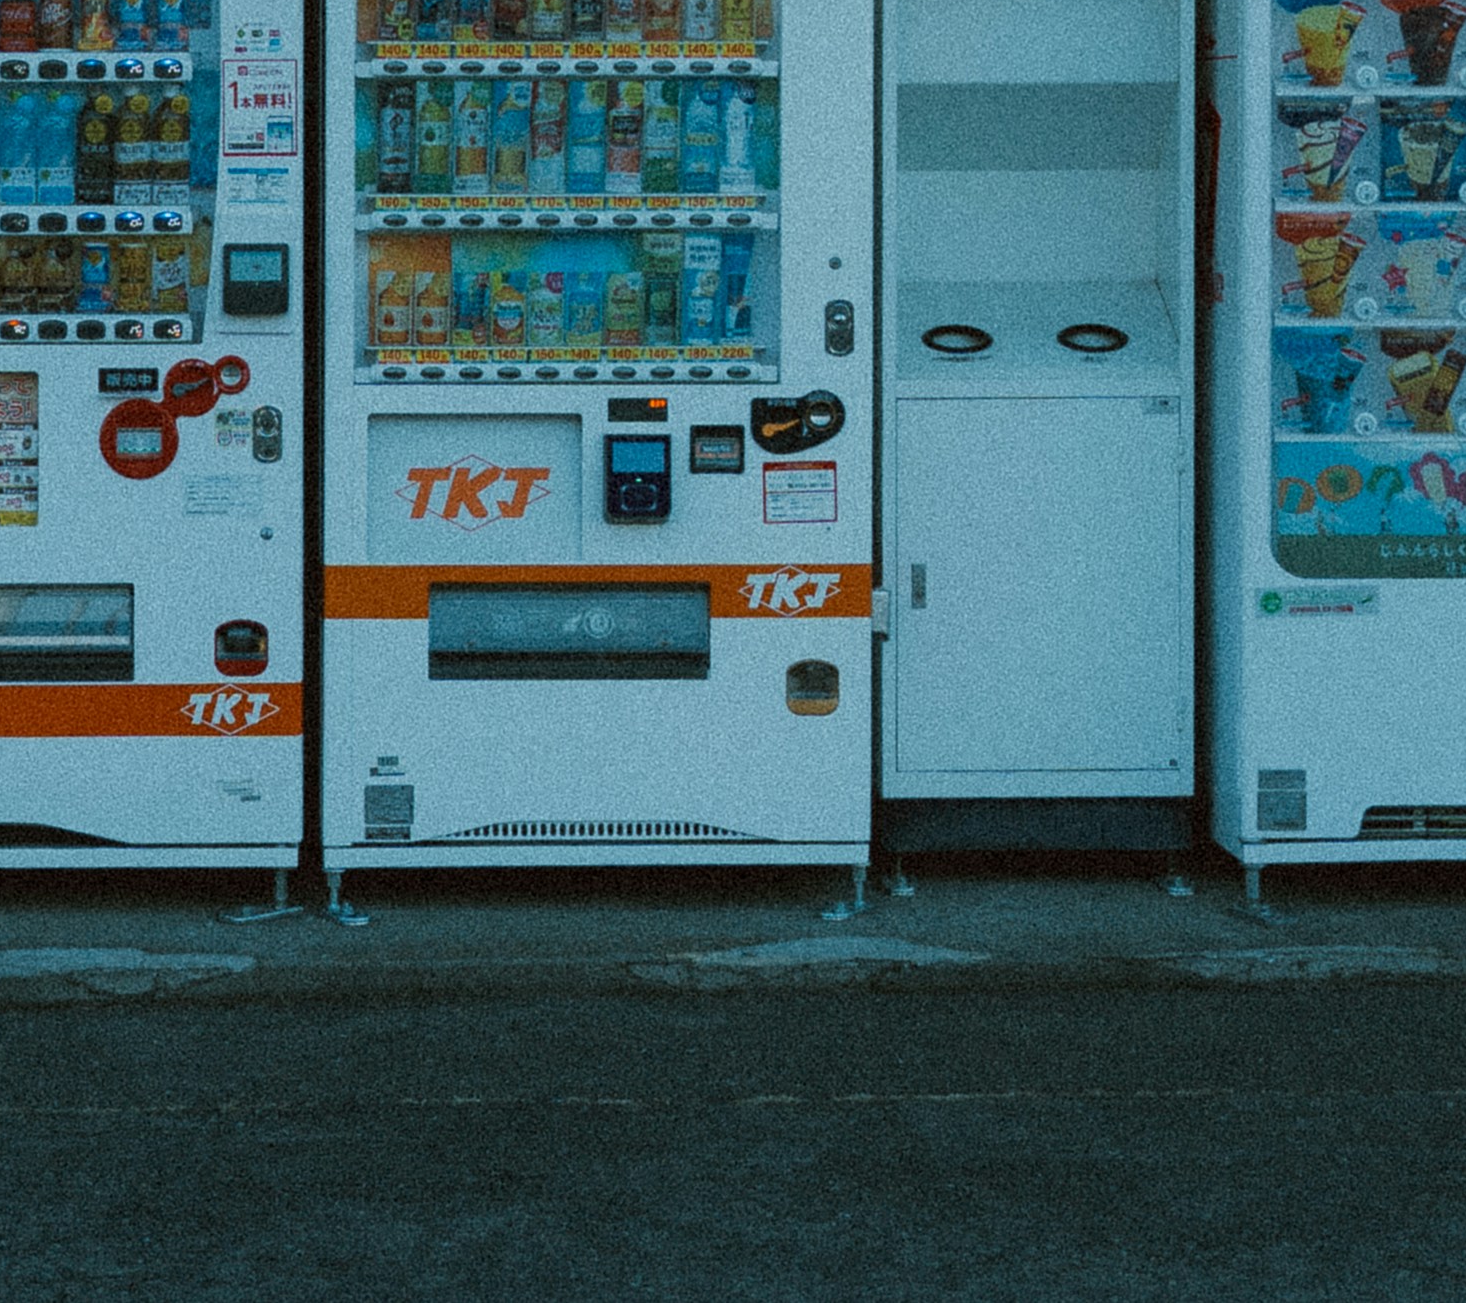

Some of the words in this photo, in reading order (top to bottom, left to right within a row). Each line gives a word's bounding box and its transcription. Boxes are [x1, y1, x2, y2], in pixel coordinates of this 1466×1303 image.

[405, 467, 552, 520] TKJ
[743, 572, 841, 609] TKJ
[189, 693, 270, 725] TKJ
